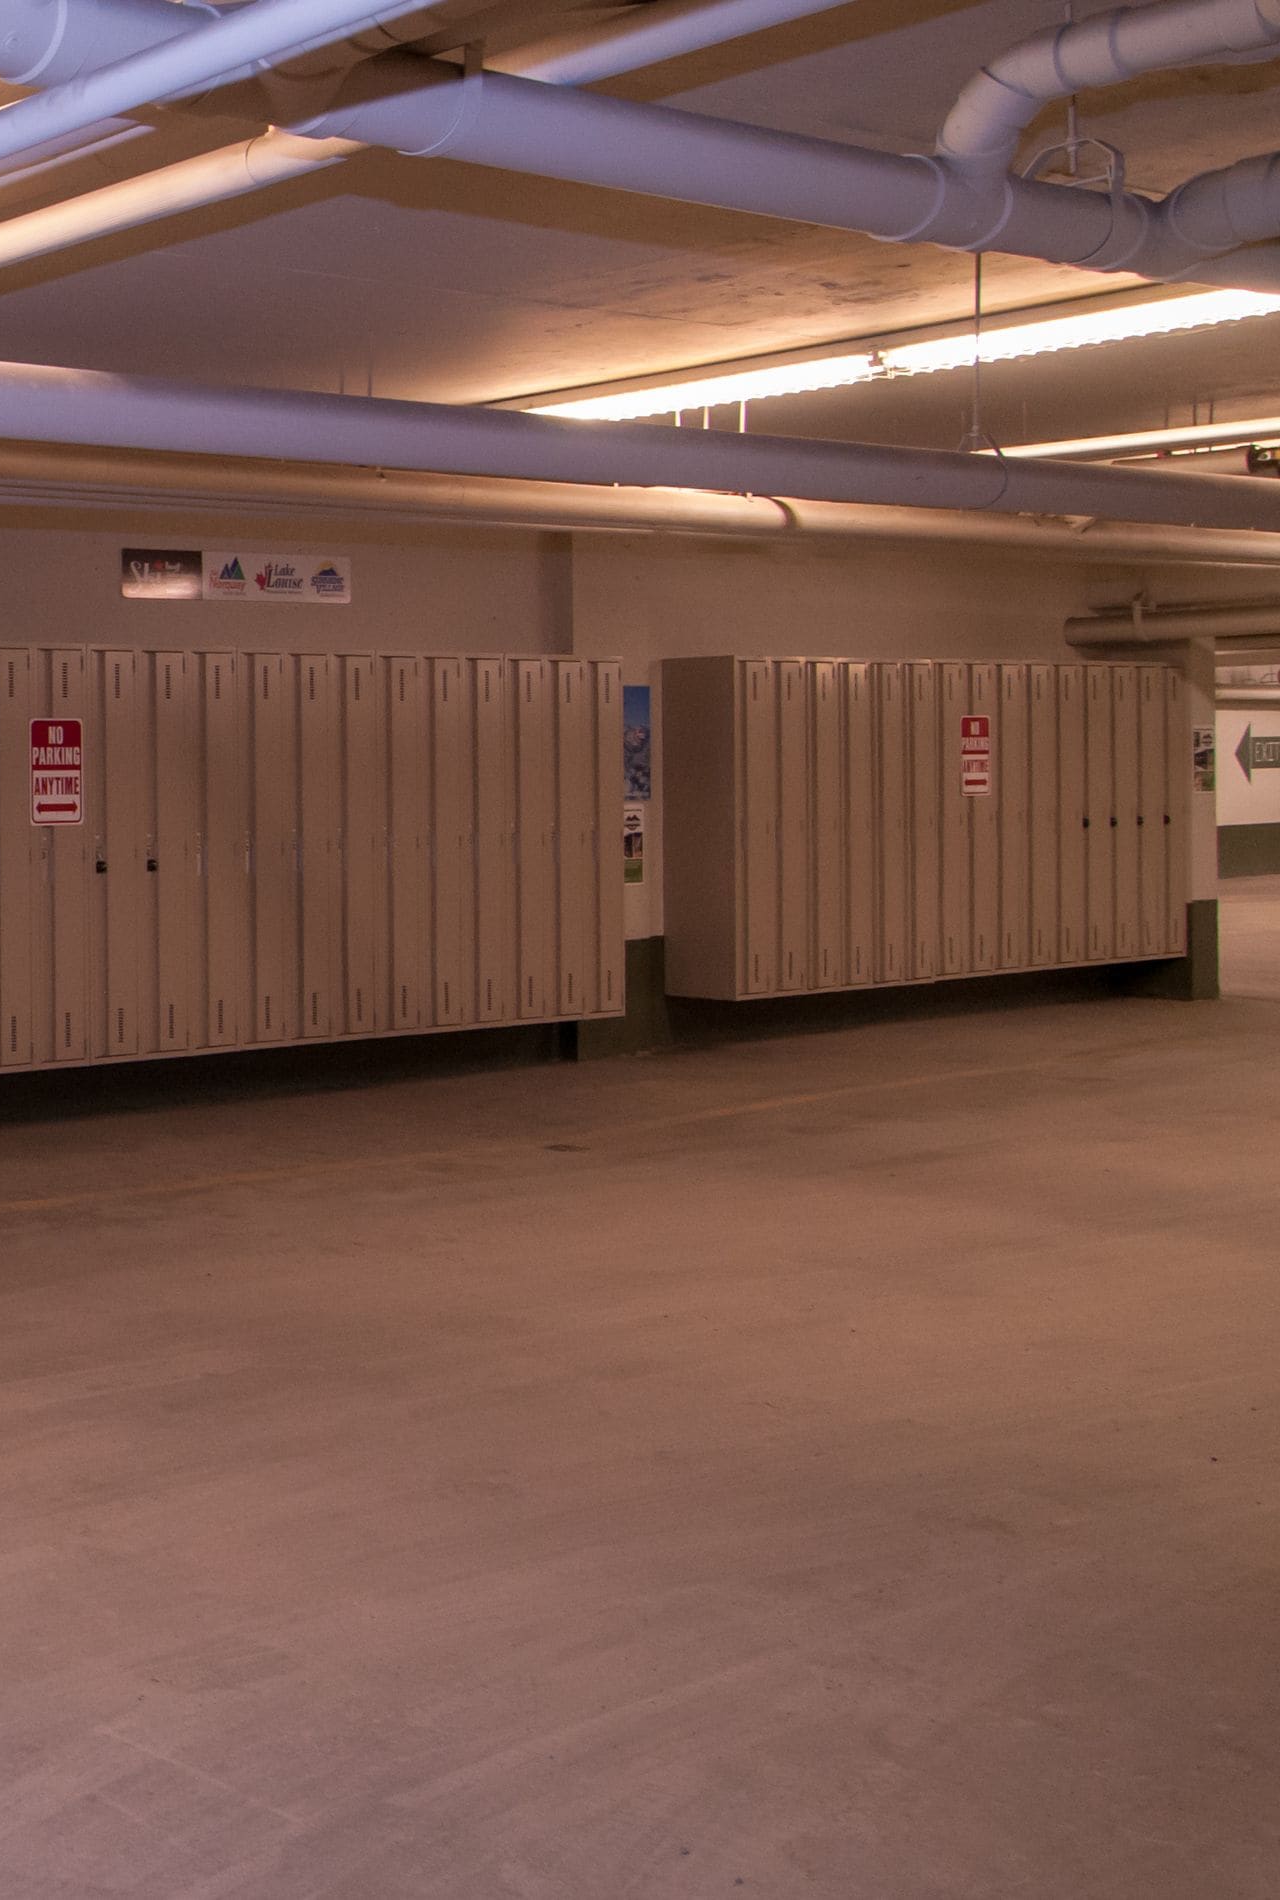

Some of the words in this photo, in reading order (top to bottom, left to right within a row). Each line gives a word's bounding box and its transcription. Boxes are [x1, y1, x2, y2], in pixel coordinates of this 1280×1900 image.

[266, 568, 303, 588] Louise
[273, 563, 296, 576] Lake
[48, 726, 64, 744] NO
[32, 747, 80, 765] PARKING
[34, 777, 79, 795] ANYTIME
